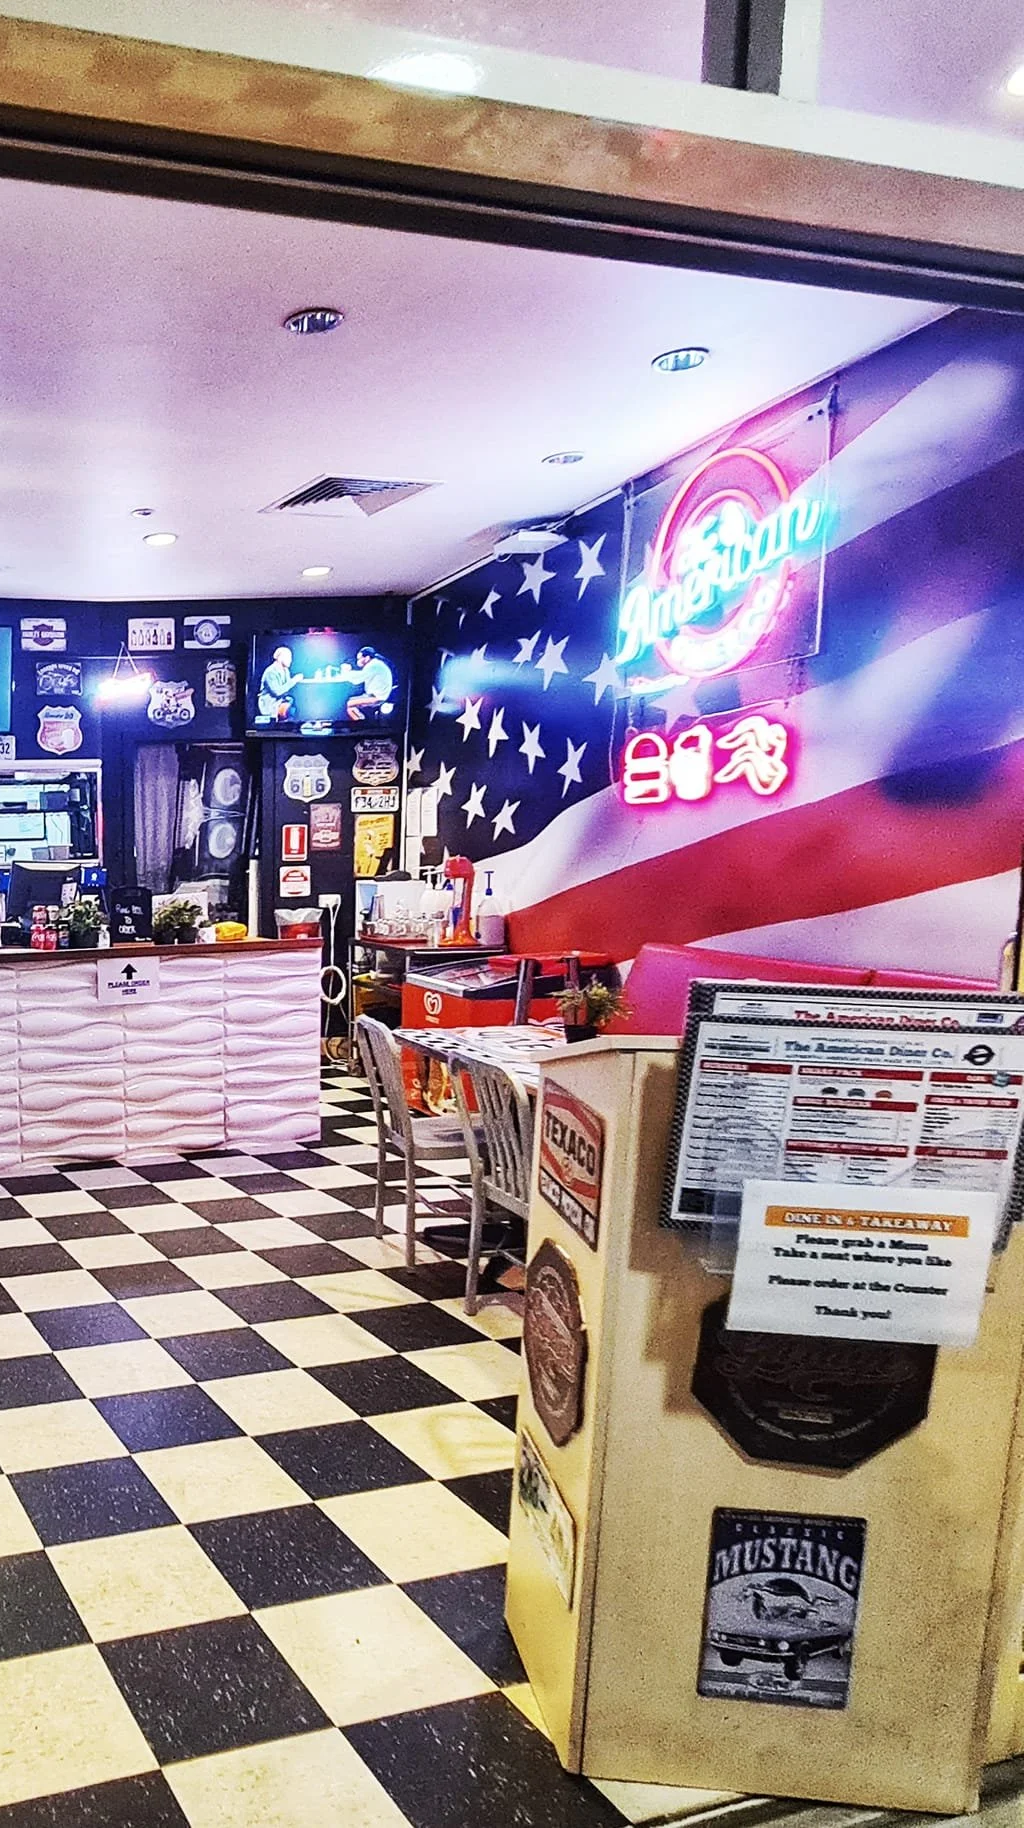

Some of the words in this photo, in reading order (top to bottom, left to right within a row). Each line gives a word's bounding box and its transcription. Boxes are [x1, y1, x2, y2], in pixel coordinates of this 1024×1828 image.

[615, 498, 824, 666] American
[794, 1010, 821, 1020] The
[826, 1012, 895, 1024] American
[900, 1014, 937, 1026] Diner
[784, 1041, 810, 1051] The
[814, 1042, 885, 1055] American
[889, 1046, 927, 1057] Diner
[932, 1048, 954, 1058] Co.
[545, 1110, 596, 1177] TEXACO
[784, 1211, 821, 1225] DINE
[826, 1214, 843, 1227] IN
[859, 1215, 953, 1232] TAKEAWAY
[796, 1234, 839, 1246] Please
[842, 1237, 873, 1250] grab
[878, 1241, 885, 1249] a
[889, 1239, 928, 1251] Menu
[773, 1247, 807, 1259] Take
[810, 1251, 818, 1259] a
[821, 1251, 850, 1262] seat
[852, 1252, 893, 1265] where
[897, 1255, 922, 1267] you
[925, 1256, 952, 1267] like
[768, 1275, 811, 1287] Please
[814, 1278, 849, 1290] order
[852, 1281, 866, 1290] at
[869, 1281, 890, 1292] the
[893, 1283, 949, 1296] Counter
[815, 1305, 858, 1318] Thank
[861, 1308, 892, 1320] you!
[713, 1537, 859, 1591] MUSTANG
